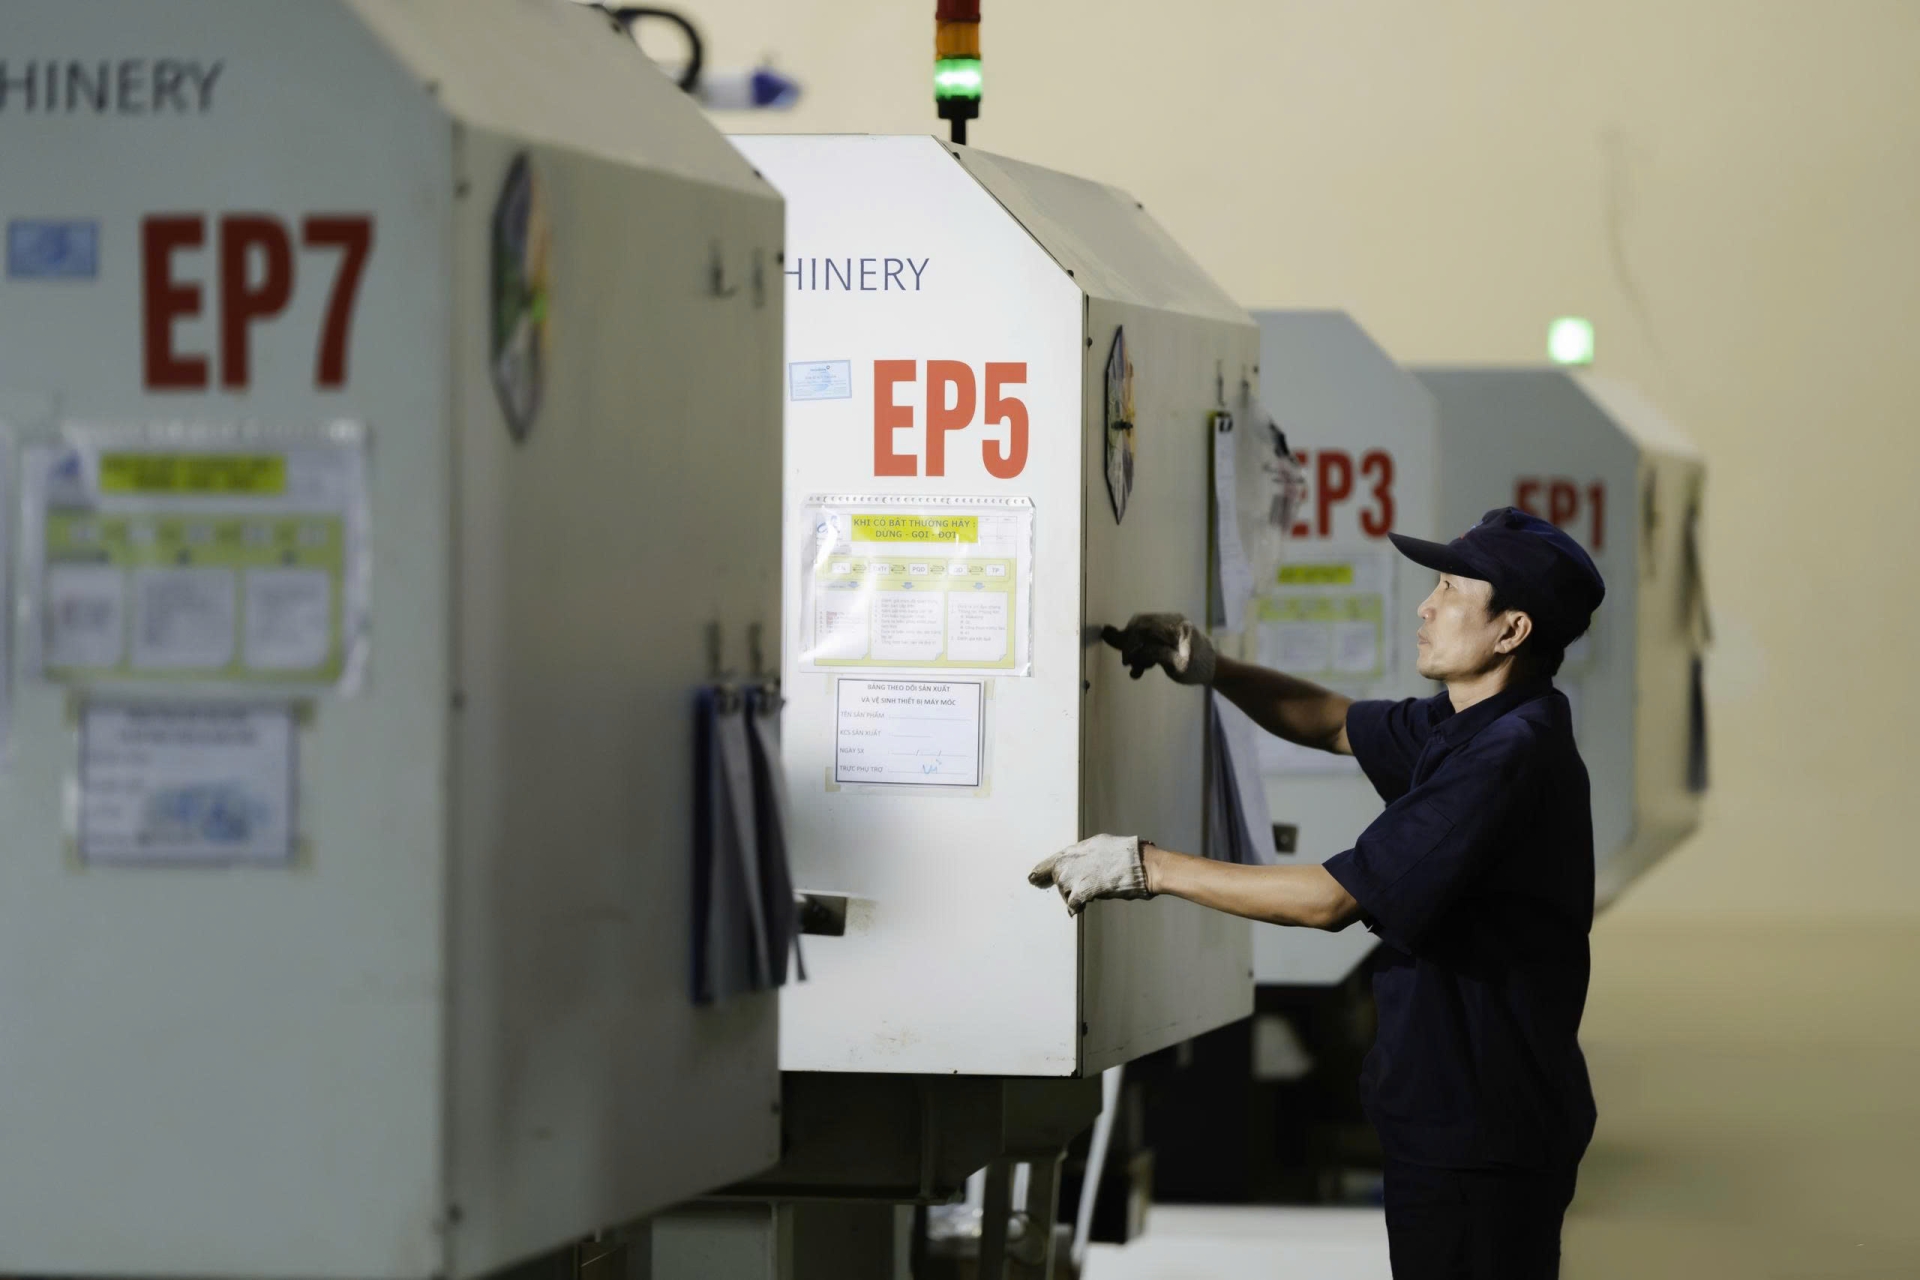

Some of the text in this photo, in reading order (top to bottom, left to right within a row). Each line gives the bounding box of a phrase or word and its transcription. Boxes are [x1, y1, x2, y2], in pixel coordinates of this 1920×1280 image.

[142, 215, 374, 389] EP7
[873, 359, 1030, 480] EP5
[853, 518, 871, 527] KHI
